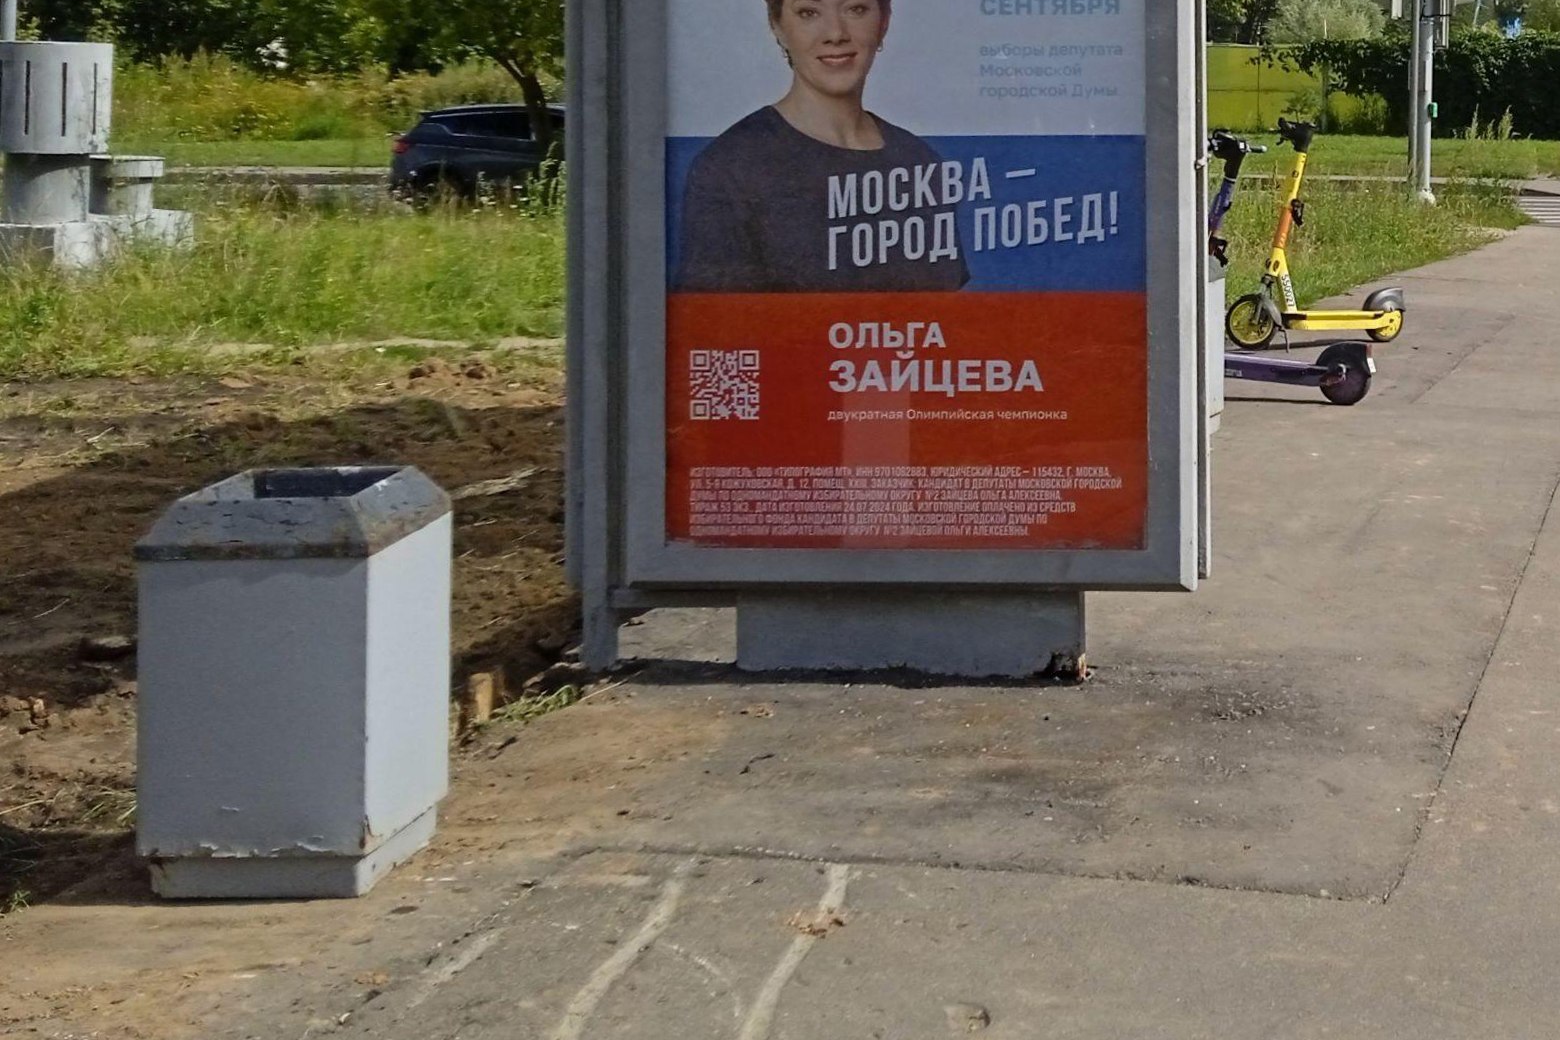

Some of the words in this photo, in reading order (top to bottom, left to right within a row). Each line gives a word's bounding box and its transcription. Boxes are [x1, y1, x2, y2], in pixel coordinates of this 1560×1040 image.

[980, 43, 1044, 58] выборы
[1048, 45, 1122, 58] депутата
[980, 63, 1082, 77] Московской
[980, 84, 1067, 99] городской
[1071, 83, 1117, 99] Думы
[827, 157, 991, 219] МОСКВА
[827, 211, 958, 270] ГОРОД
[973, 191, 1120, 252] ПОБЕД!
[828, 321, 946, 349] ОЛЬГА
[828, 350, 1044, 397] ЗАЙЦЕВА
[827, 410, 903, 421] двукратная
[907, 408, 994, 420] Олимпийская
[997, 410, 1068, 420] чемпионка
[995, 466, 1021, 477] АДРЕС
[972, 478, 1016, 489] ДЕПУТАТЫ
[1074, 476, 1122, 489] ГОРОДСКОЙ
[981, 490, 1006, 500] ОЛЬГА
[1040, 502, 1076, 512] СРЕДСТВ
